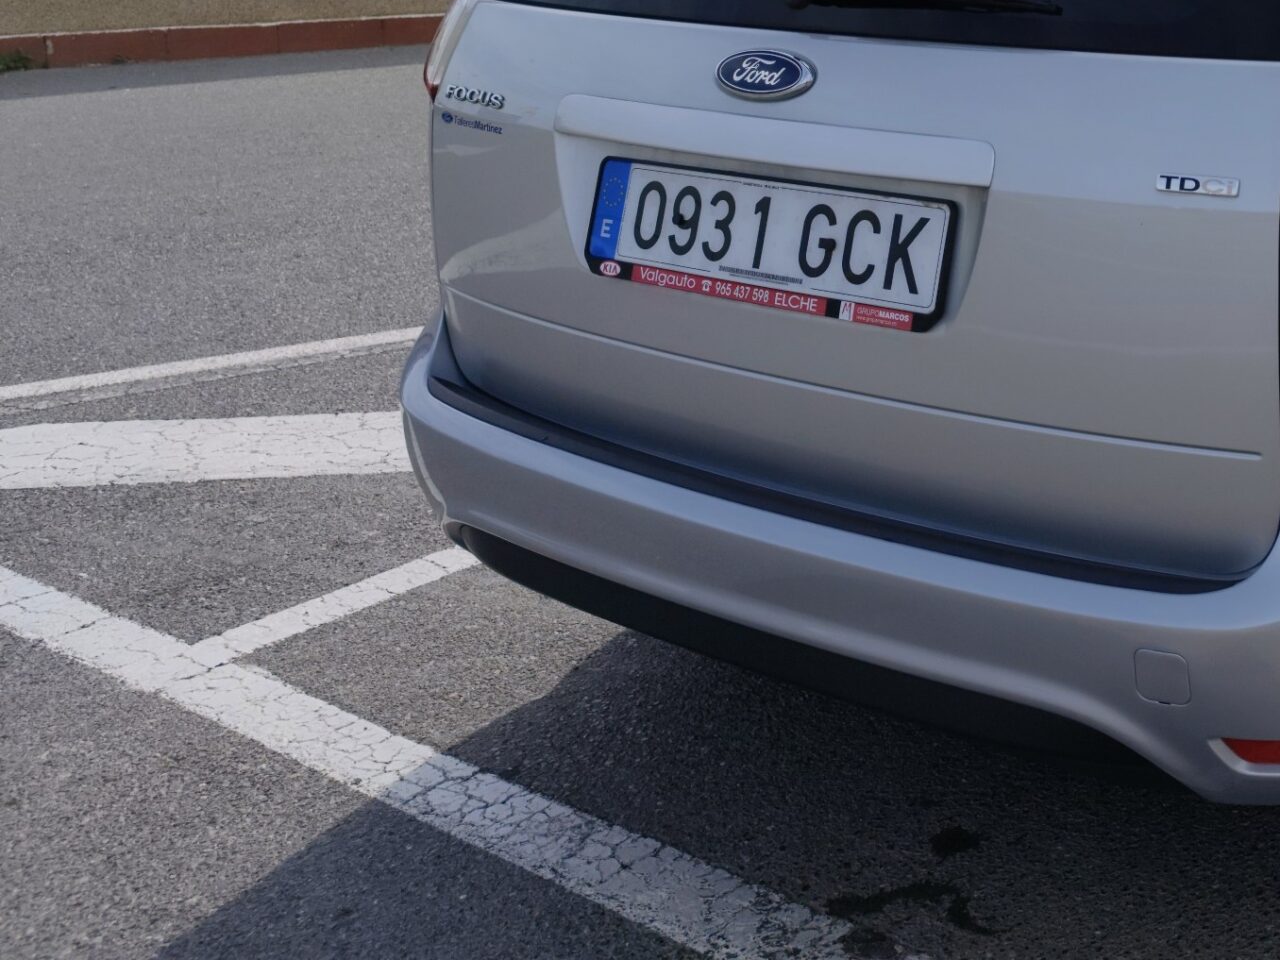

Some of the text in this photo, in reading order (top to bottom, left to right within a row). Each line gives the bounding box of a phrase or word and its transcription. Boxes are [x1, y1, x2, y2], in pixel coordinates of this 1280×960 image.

[732, 56, 787, 86] Ford
[445, 84, 506, 110] FOCUS
[1159, 174, 1234, 195] TDCi
[600, 219, 614, 239] E
[633, 180, 931, 295] 0931 GCK
[602, 262, 619, 275] KIA
[640, 266, 819, 313] Valgauto 965 437 598 ELCHE
